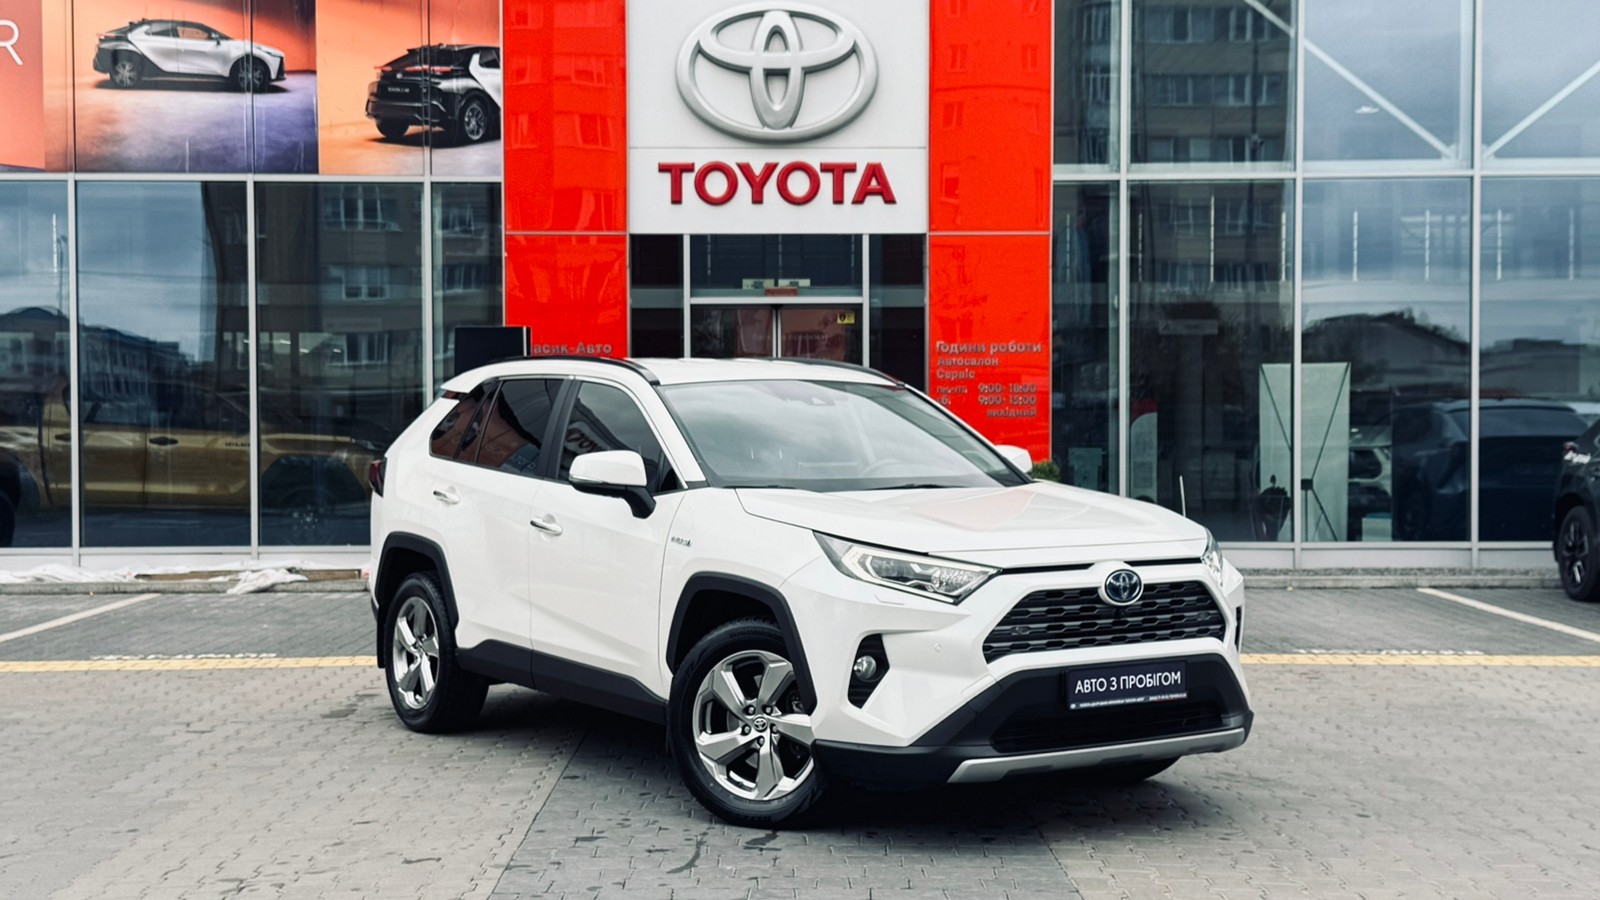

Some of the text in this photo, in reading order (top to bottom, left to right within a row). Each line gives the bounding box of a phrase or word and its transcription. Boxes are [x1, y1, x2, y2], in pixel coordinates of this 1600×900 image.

[658, 161, 897, 206] TOYOTA
[531, 341, 612, 354] асик-Авто
[937, 341, 1042, 355] Години роботи
[937, 356, 999, 366] Автосалон
[936, 368, 975, 381] Сервіс
[1009, 383, 1037, 393] 18:00
[1075, 678, 1107, 694] АВТО
[1120, 671, 1181, 690] ПРОБІГОМ
